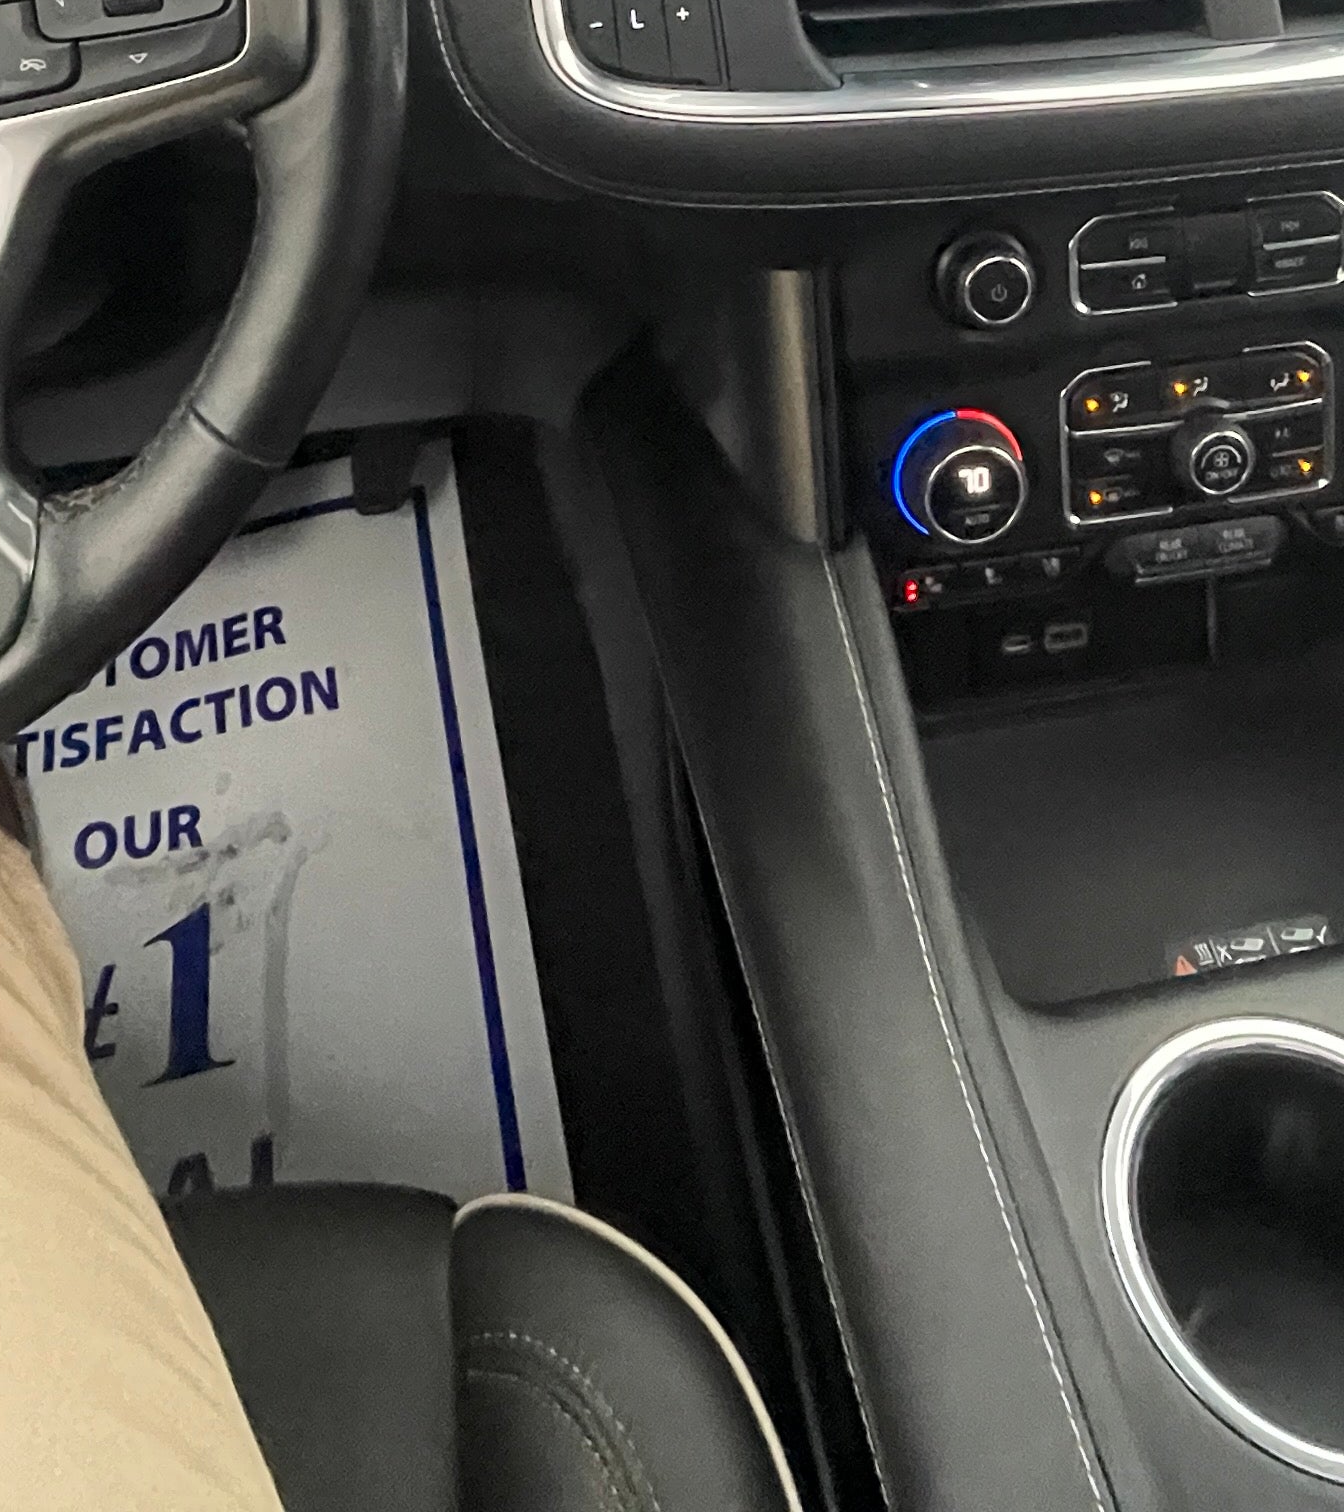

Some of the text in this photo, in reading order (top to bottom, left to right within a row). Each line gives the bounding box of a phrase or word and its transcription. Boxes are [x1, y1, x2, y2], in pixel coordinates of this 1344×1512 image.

[629, 8, 645, 30] L
[958, 466, 992, 494] 70
[73, 803, 203, 871] OUR
